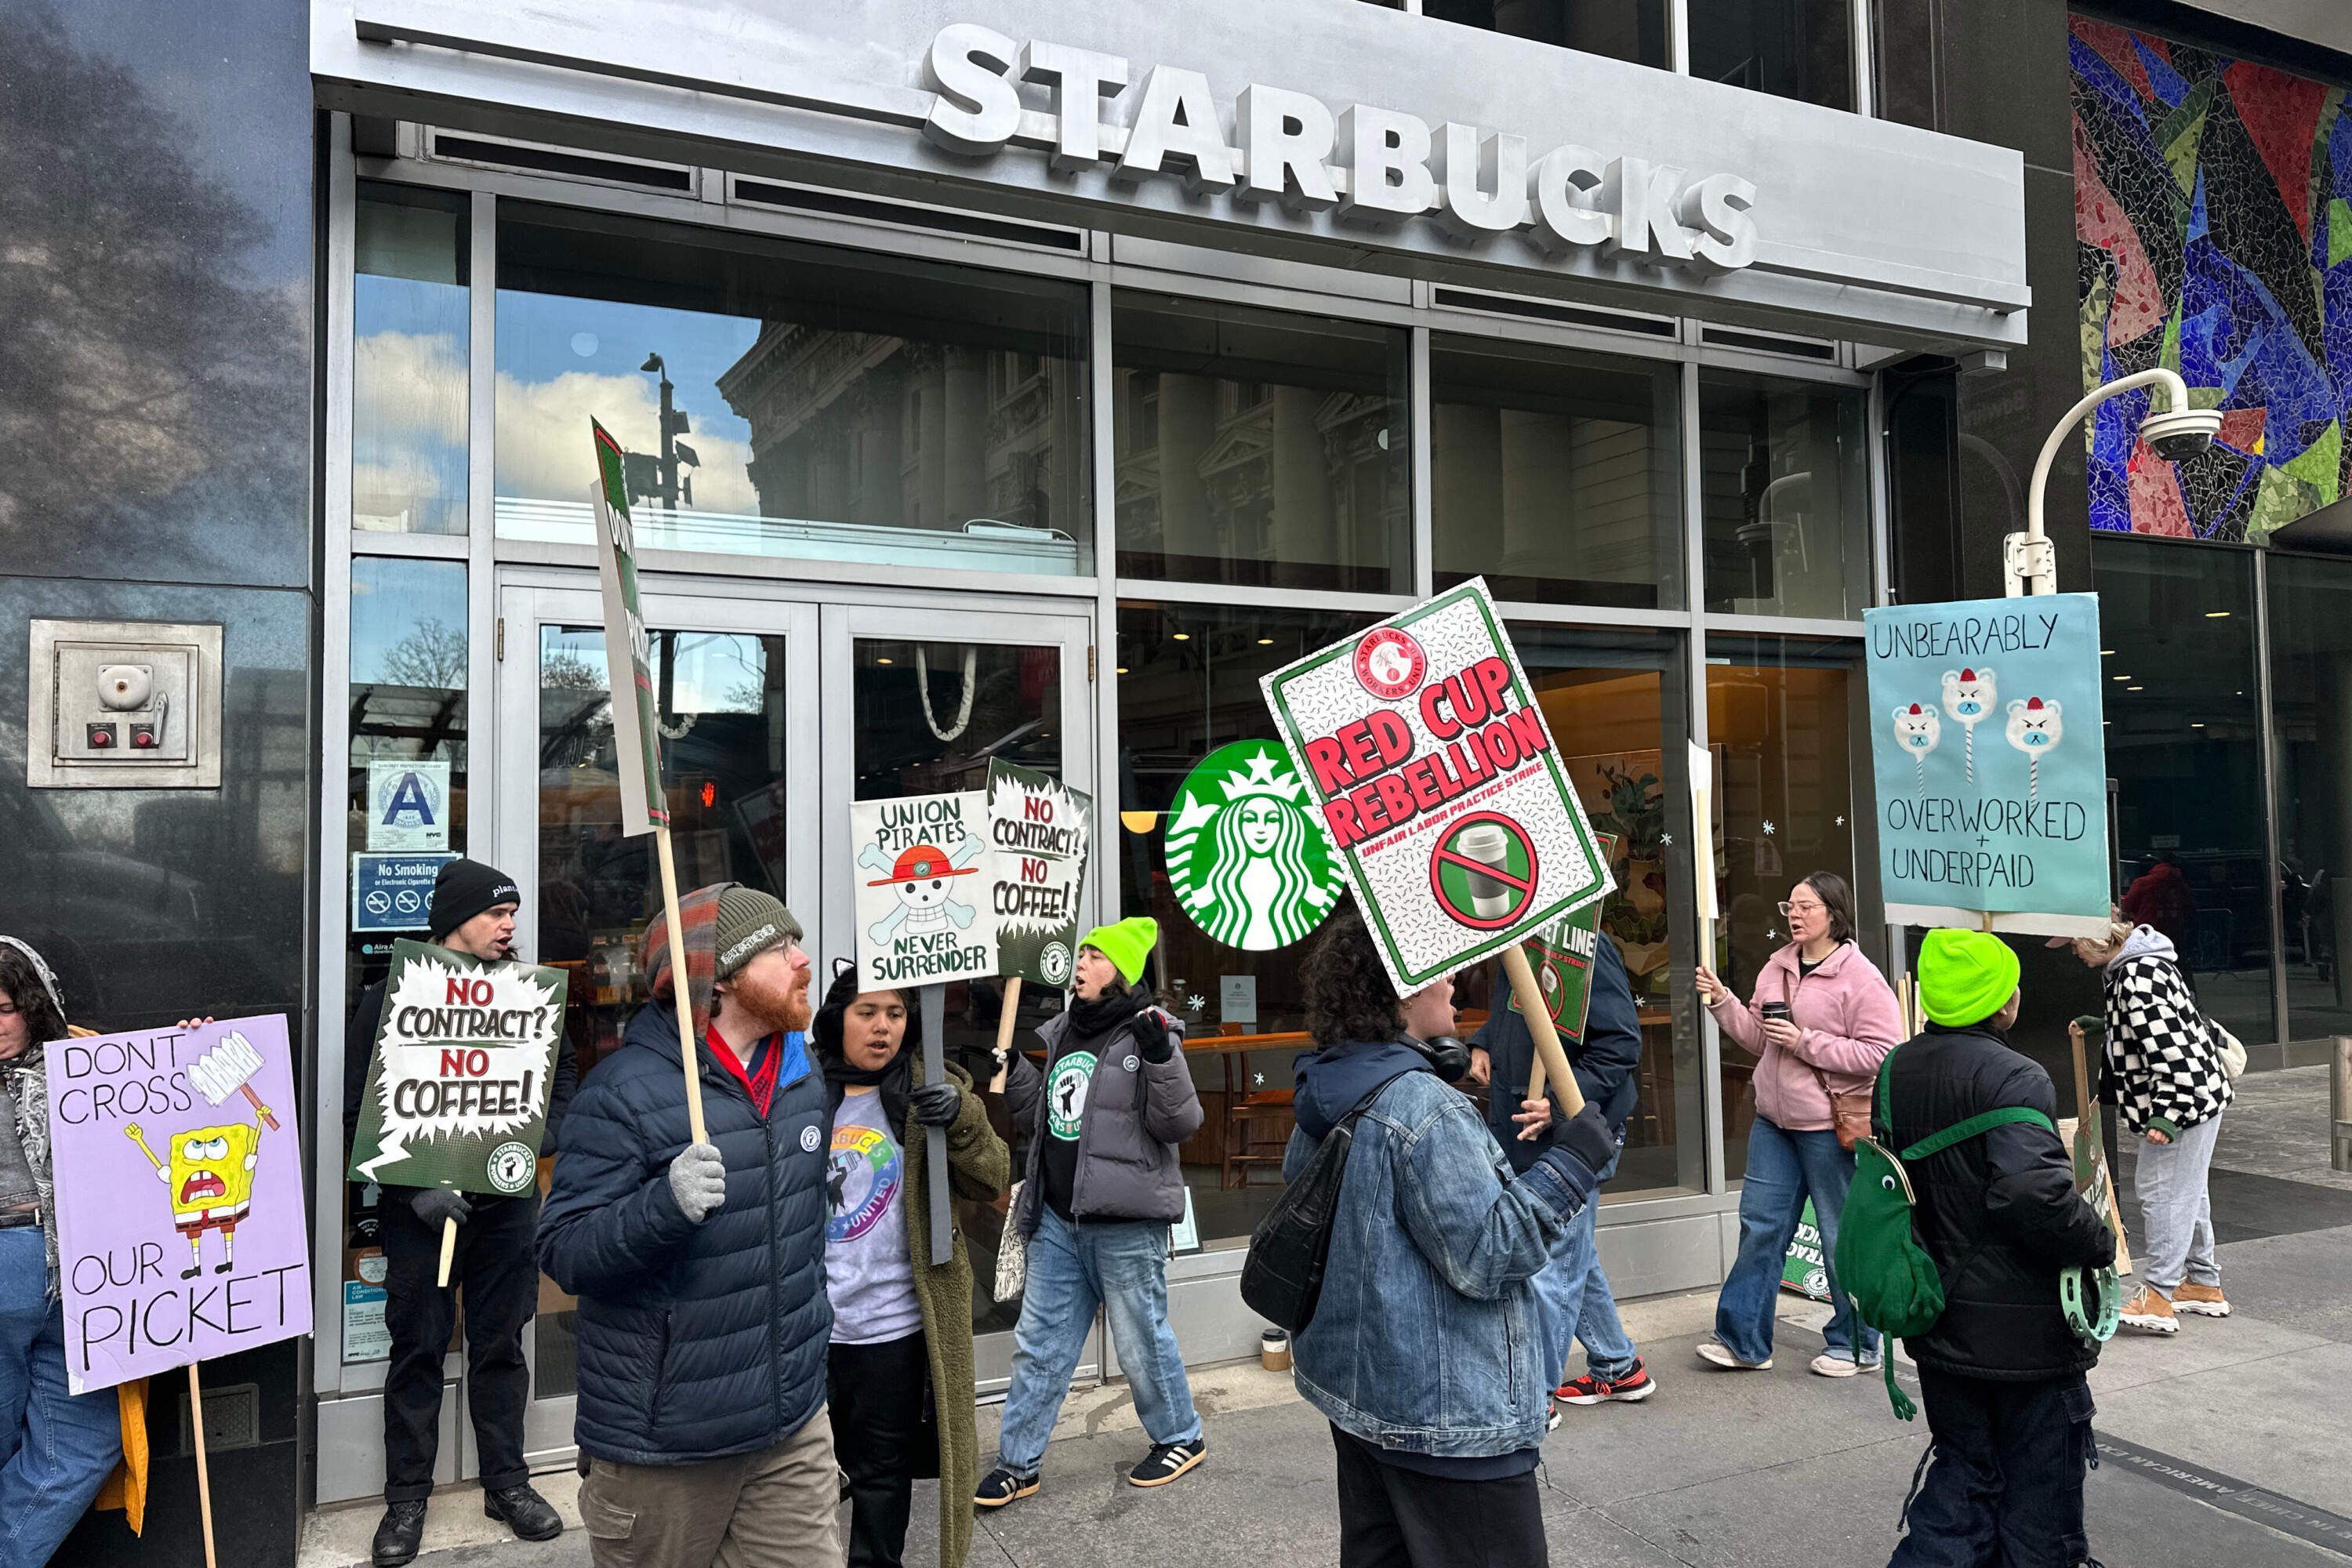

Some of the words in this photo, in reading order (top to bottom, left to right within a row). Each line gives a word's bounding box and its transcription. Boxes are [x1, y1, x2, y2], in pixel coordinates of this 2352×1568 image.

[924, 23, 1759, 274] STARBUCKS
[1359, 632, 1406, 662] STARBUCKS
[1874, 613, 2059, 659] UNBEARABLY
[1362, 669, 1404, 695] WORKERS
[1408, 648, 1421, 685] UNITED
[1305, 709, 1415, 798] RED
[1419, 656, 1513, 742] CUP
[1322, 706, 1552, 850] REBELLION
[382, 772, 435, 825] A
[880, 797, 960, 829] UNION
[1024, 796, 1054, 823] NO
[1361, 830, 1407, 858] UNFAIR
[1409, 811, 1449, 837] LABOR
[1450, 783, 1504, 816] PRACTICE
[1505, 761, 1544, 787] STRIKE
[876, 820, 966, 851] PIRATES
[993, 817, 1081, 855] CONTRACT?
[1888, 798, 2085, 841] OVERWORKED
[378, 864, 392, 877] No
[394, 863, 438, 877] Smoking
[1021, 857, 1047, 884] NO
[1892, 848, 2034, 887] UNDERPAID
[993, 880, 1071, 920] COFFEE!
[894, 932, 958, 956] NEVER
[1563, 924, 1595, 958] LINE
[873, 946, 986, 981] SURRENDER
[445, 978, 494, 1007] NO
[397, 1006, 548, 1040] CONTRACT?
[65, 1034, 187, 1079] DONT
[440, 1049, 490, 1077] NO
[59, 1072, 192, 1125] CROSS
[394, 1069, 534, 1119] COFFEE!
[496, 1145, 532, 1161] STARBUCKS
[491, 1164, 509, 1189] WORKERS
[515, 1167, 532, 1188] UNITED
[850, 1178, 891, 1229] UNITED
[72, 1242, 164, 1295] OUR
[81, 1264, 305, 1372] PICKET
[2128, 1454, 2236, 1494] AMERICAN
